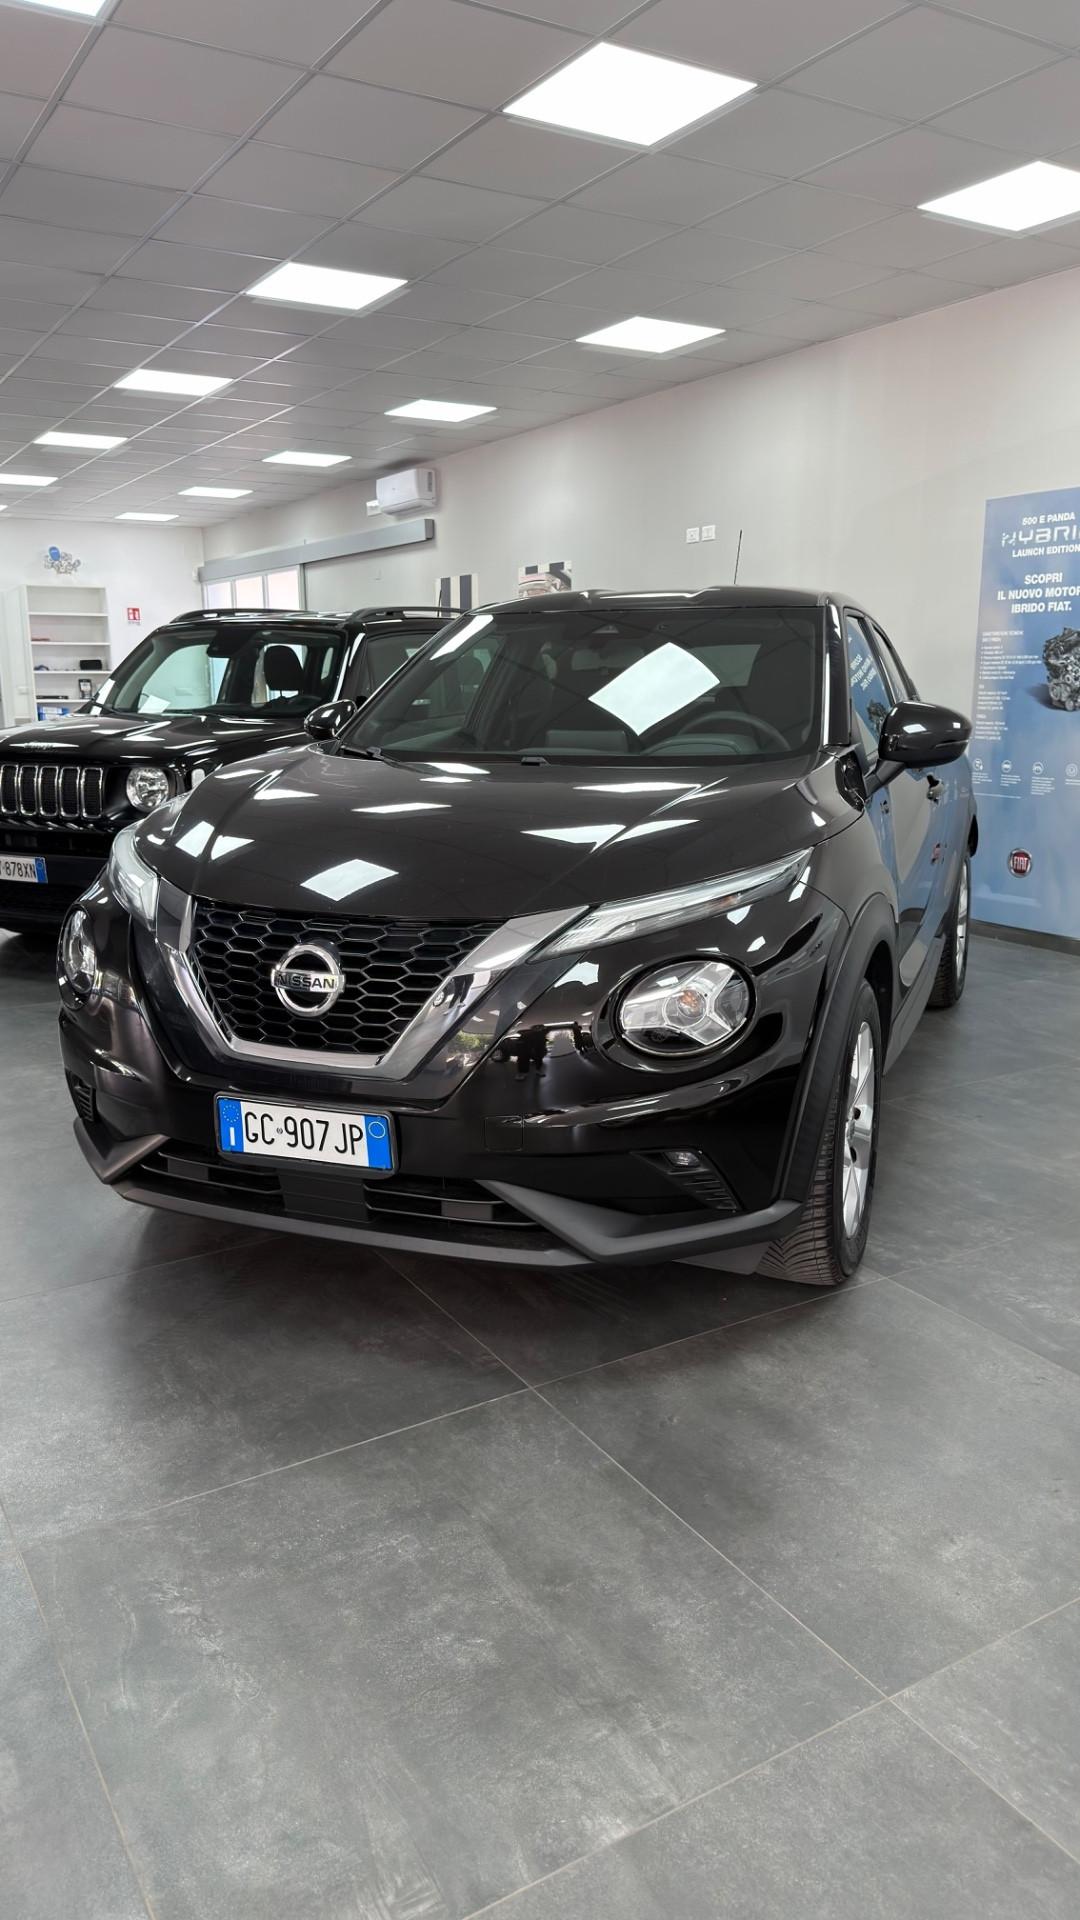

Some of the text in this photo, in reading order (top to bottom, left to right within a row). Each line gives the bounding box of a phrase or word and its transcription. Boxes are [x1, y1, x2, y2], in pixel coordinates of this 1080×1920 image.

[1022, 511, 1076, 526] 500 E PANDA
[1001, 525, 1080, 548] HYBRI
[1012, 543, 1080, 558] LAUNCH EDITION
[1024, 572, 1063, 585] SCOPRI
[997, 590, 1006, 601] IL
[1008, 588, 1043, 600] NUOVO
[1011, 600, 1072, 614] IBRIDO FIAT.
[1013, 856, 1029, 871] FIAT
[277, 972, 335, 990] NISSAN
